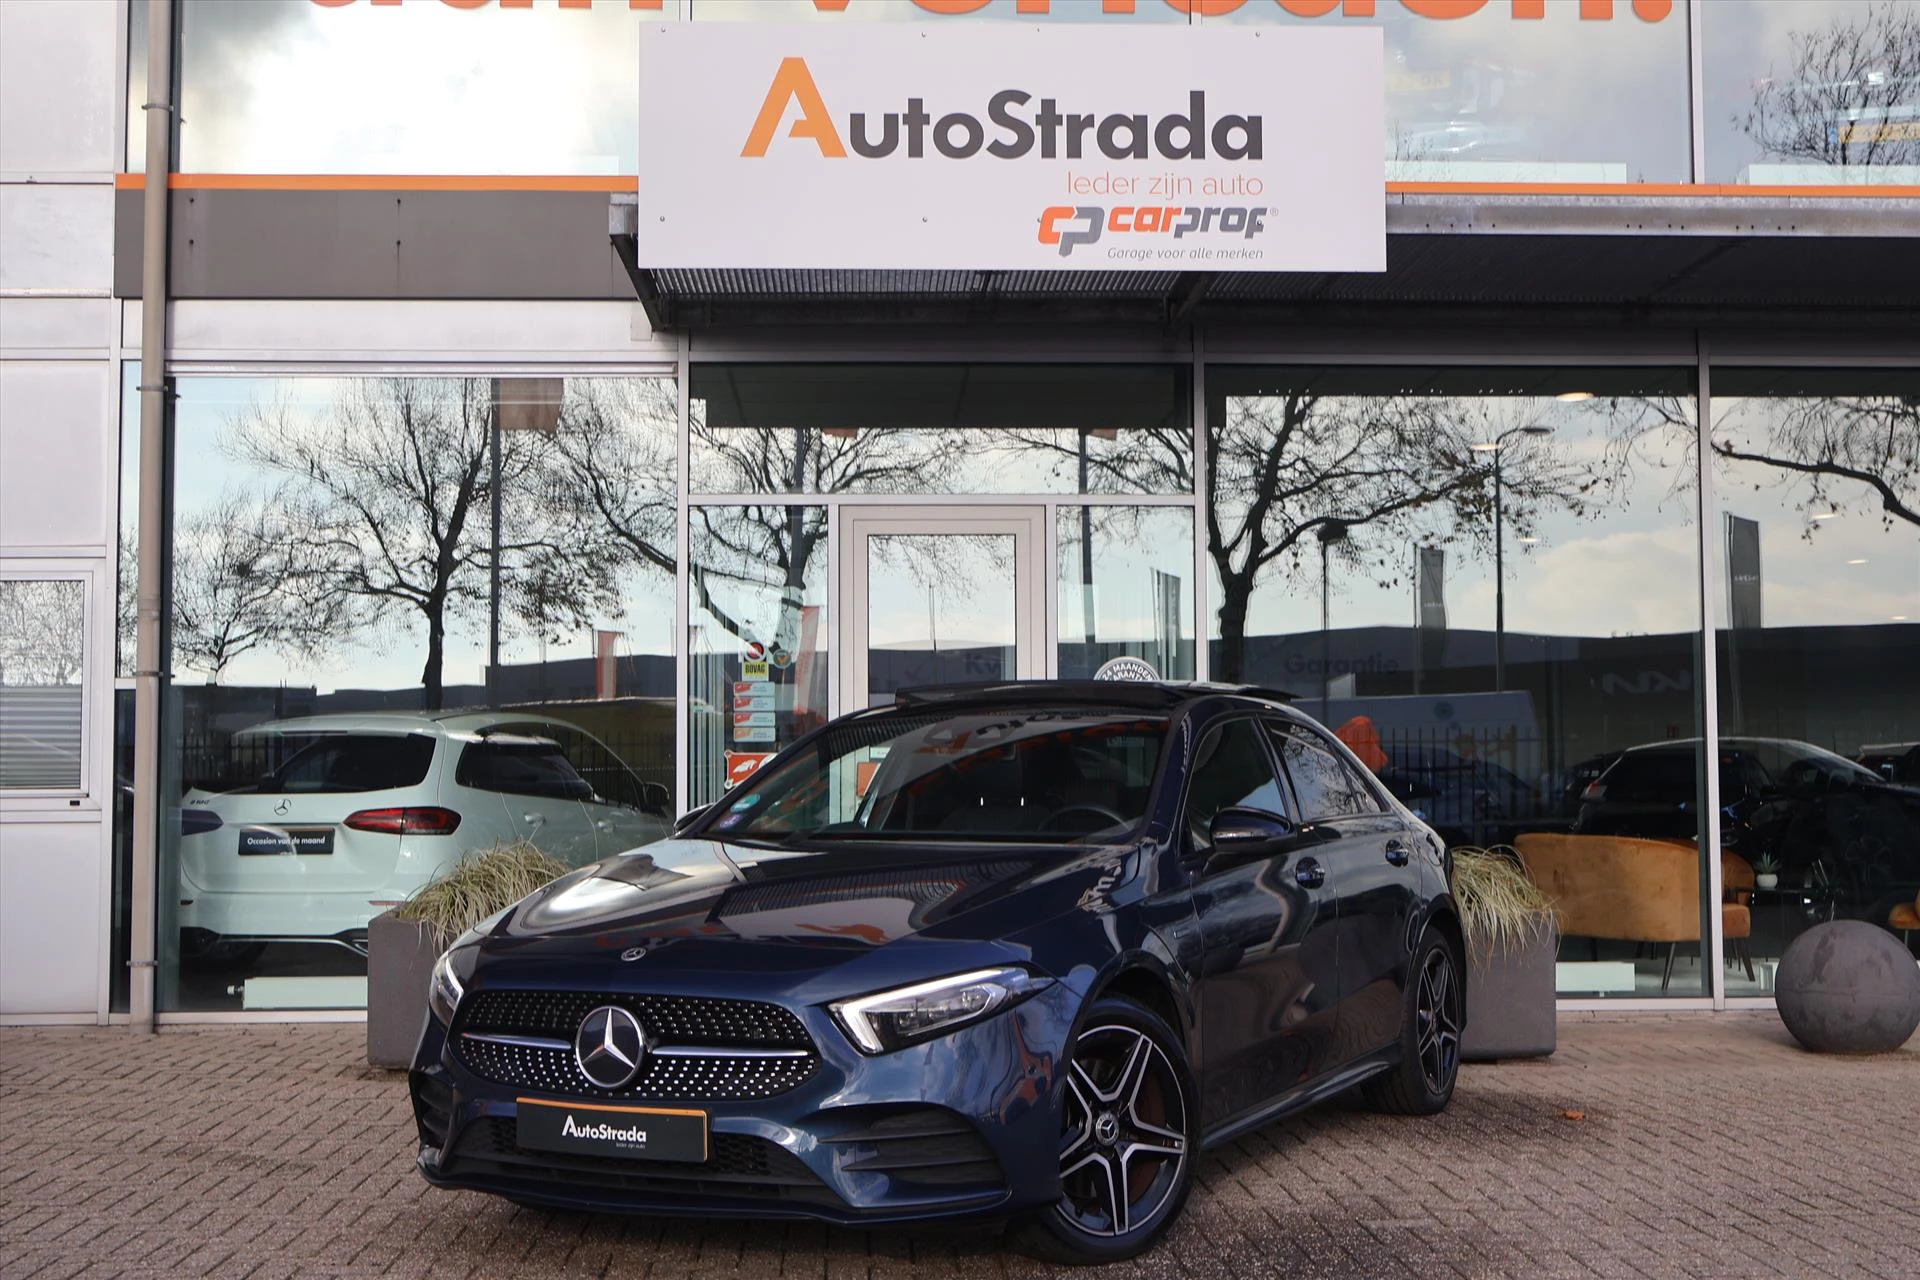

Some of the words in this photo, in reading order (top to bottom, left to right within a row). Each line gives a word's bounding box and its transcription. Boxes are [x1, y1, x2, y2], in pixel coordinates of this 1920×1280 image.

[740, 57, 1263, 160] AutoStrada
[1067, 171, 1140, 195] Ieder
[1148, 172, 1193, 200] zijn
[1202, 174, 1264, 195] auto
[1107, 247, 1153, 263] Garage
[1157, 251, 1186, 260] voor
[1189, 247, 1212, 260] alle
[1216, 247, 1264, 260] merken
[745, 663, 765, 674] BOVAG
[1112, 662, 1154, 681] MAANDEN
[1284, 651, 1399, 674] Garantie
[247, 837, 277, 845] Occasion
[291, 836, 300, 845] de
[301, 836, 326, 844] maand
[561, 1115, 647, 1142] AutoStrada
